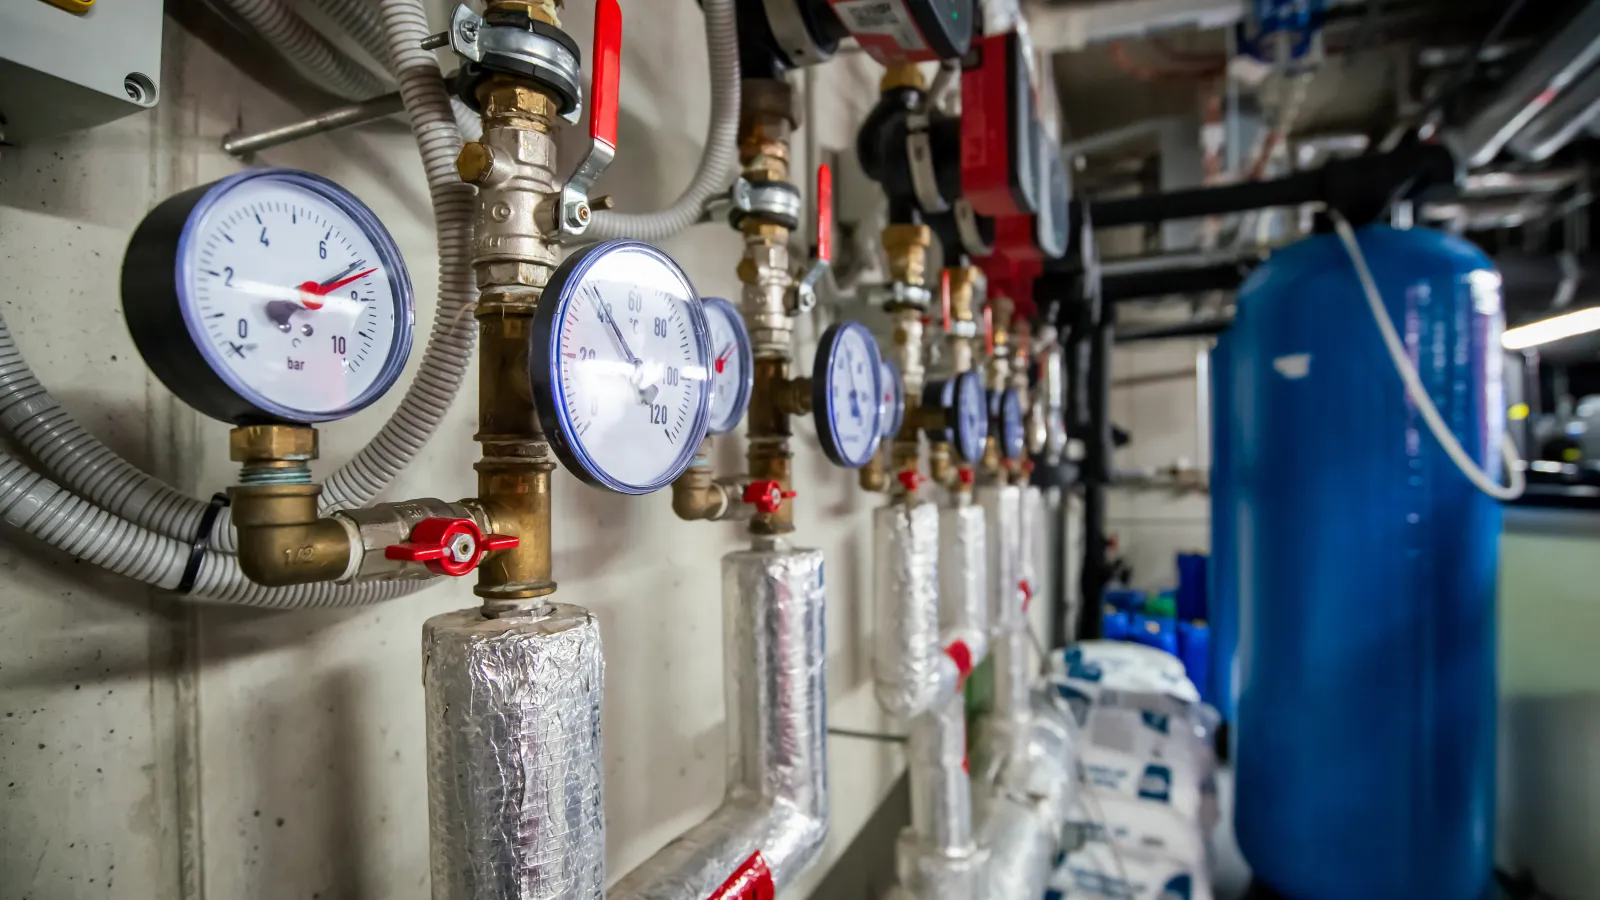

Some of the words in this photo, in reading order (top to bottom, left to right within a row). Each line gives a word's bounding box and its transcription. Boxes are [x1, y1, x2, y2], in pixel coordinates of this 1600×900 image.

[260, 226, 270, 247] 4
[318, 240, 327, 260] 6
[224, 266, 234, 288] 2
[628, 290, 642, 313] 60
[238, 318, 248, 339] 0
[653, 316, 668, 338] 80
[331, 335, 346, 355] 10
[287, 356, 305, 371] bar
[650, 404, 668, 425] 120
[283, 545, 316, 568] 1/2
